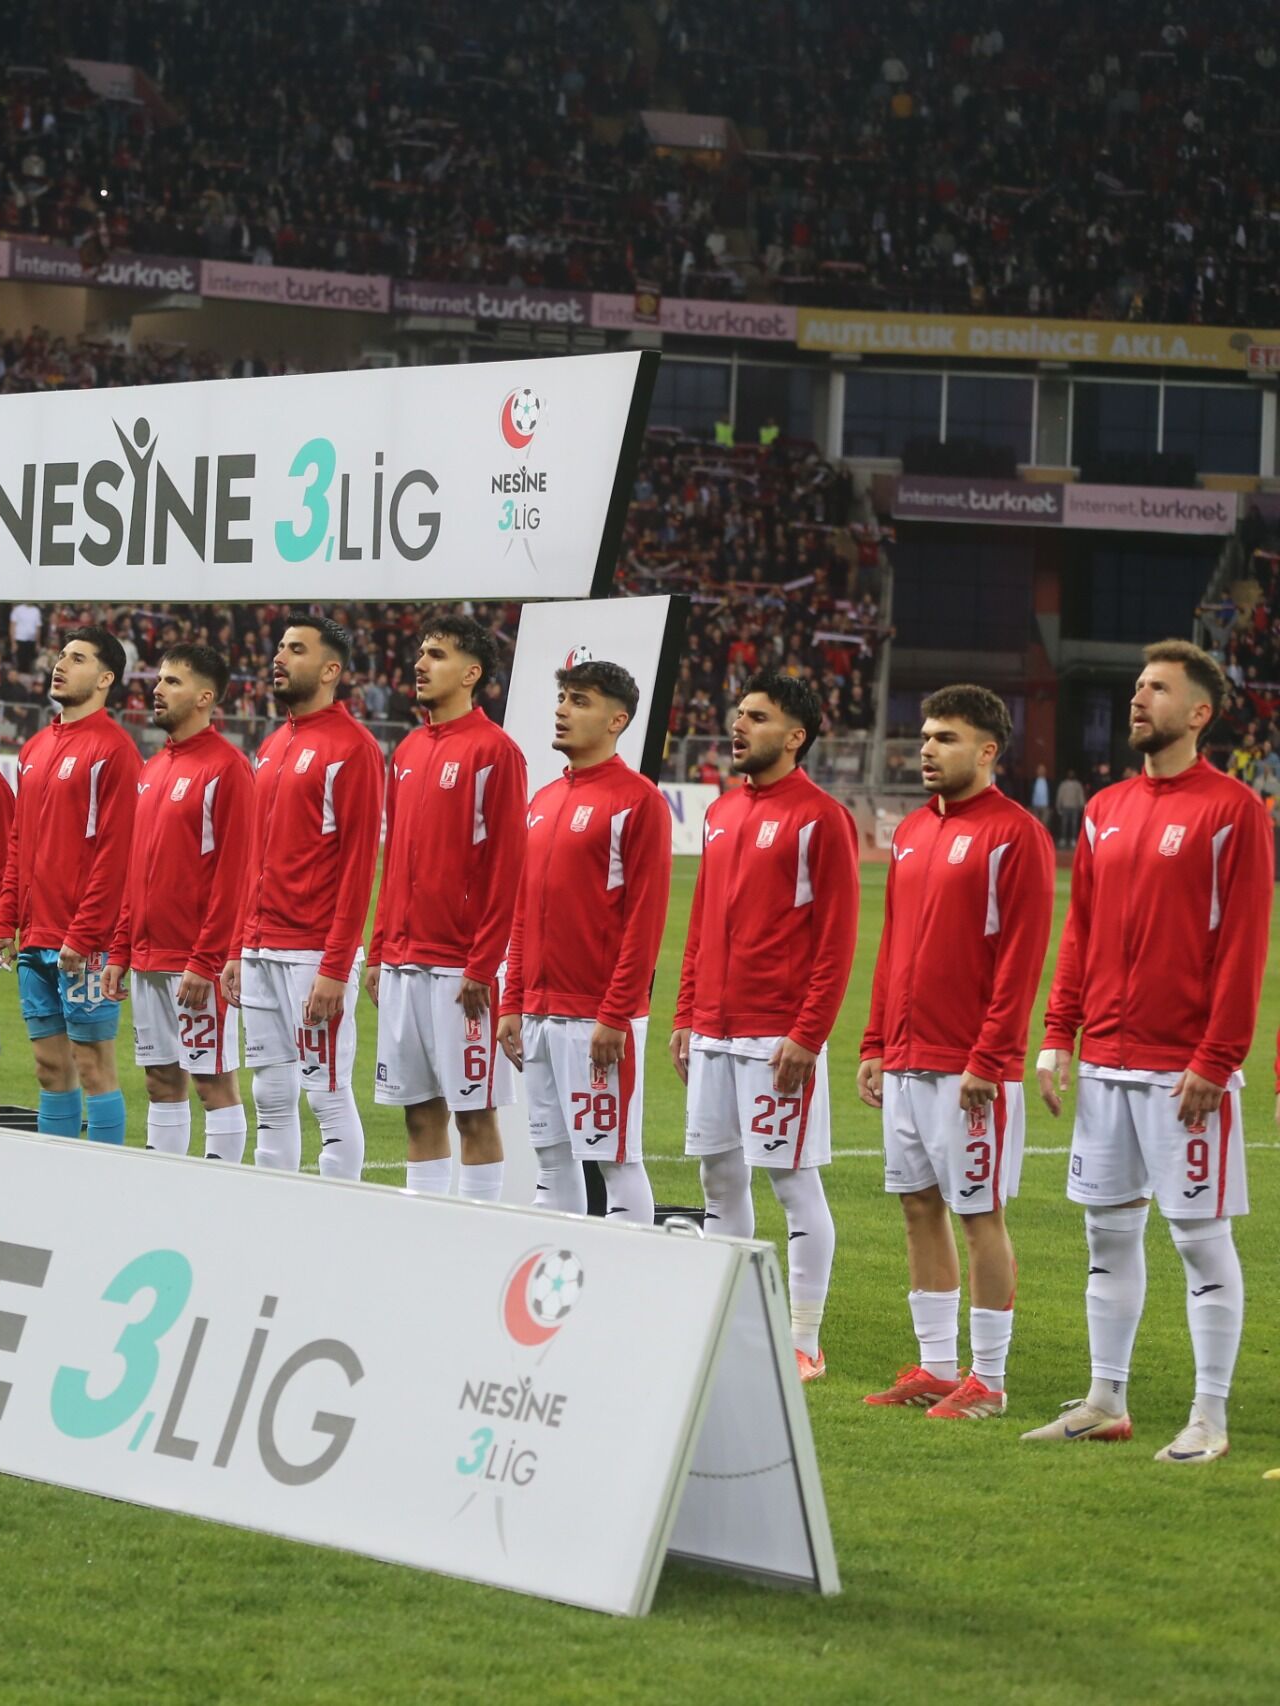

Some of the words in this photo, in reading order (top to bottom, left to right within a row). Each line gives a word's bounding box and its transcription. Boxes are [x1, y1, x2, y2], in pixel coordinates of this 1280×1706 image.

[286, 276, 382, 309] turknet
[477, 291, 585, 324] turknet
[684, 307, 788, 337] turknet
[804, 319, 956, 350] MUTLULUK
[970, 321, 1098, 358] DENİNCE
[970, 488, 1058, 514] turknet
[1140, 498, 1228, 522] turknet
[178, 1013, 215, 1048] 22
[464, 1045, 486, 1081] 6
[571, 1092, 617, 1131] 78
[751, 1095, 800, 1136] 27
[965, 1141, 990, 1182] 3
[1187, 1139, 1209, 1182] 9
